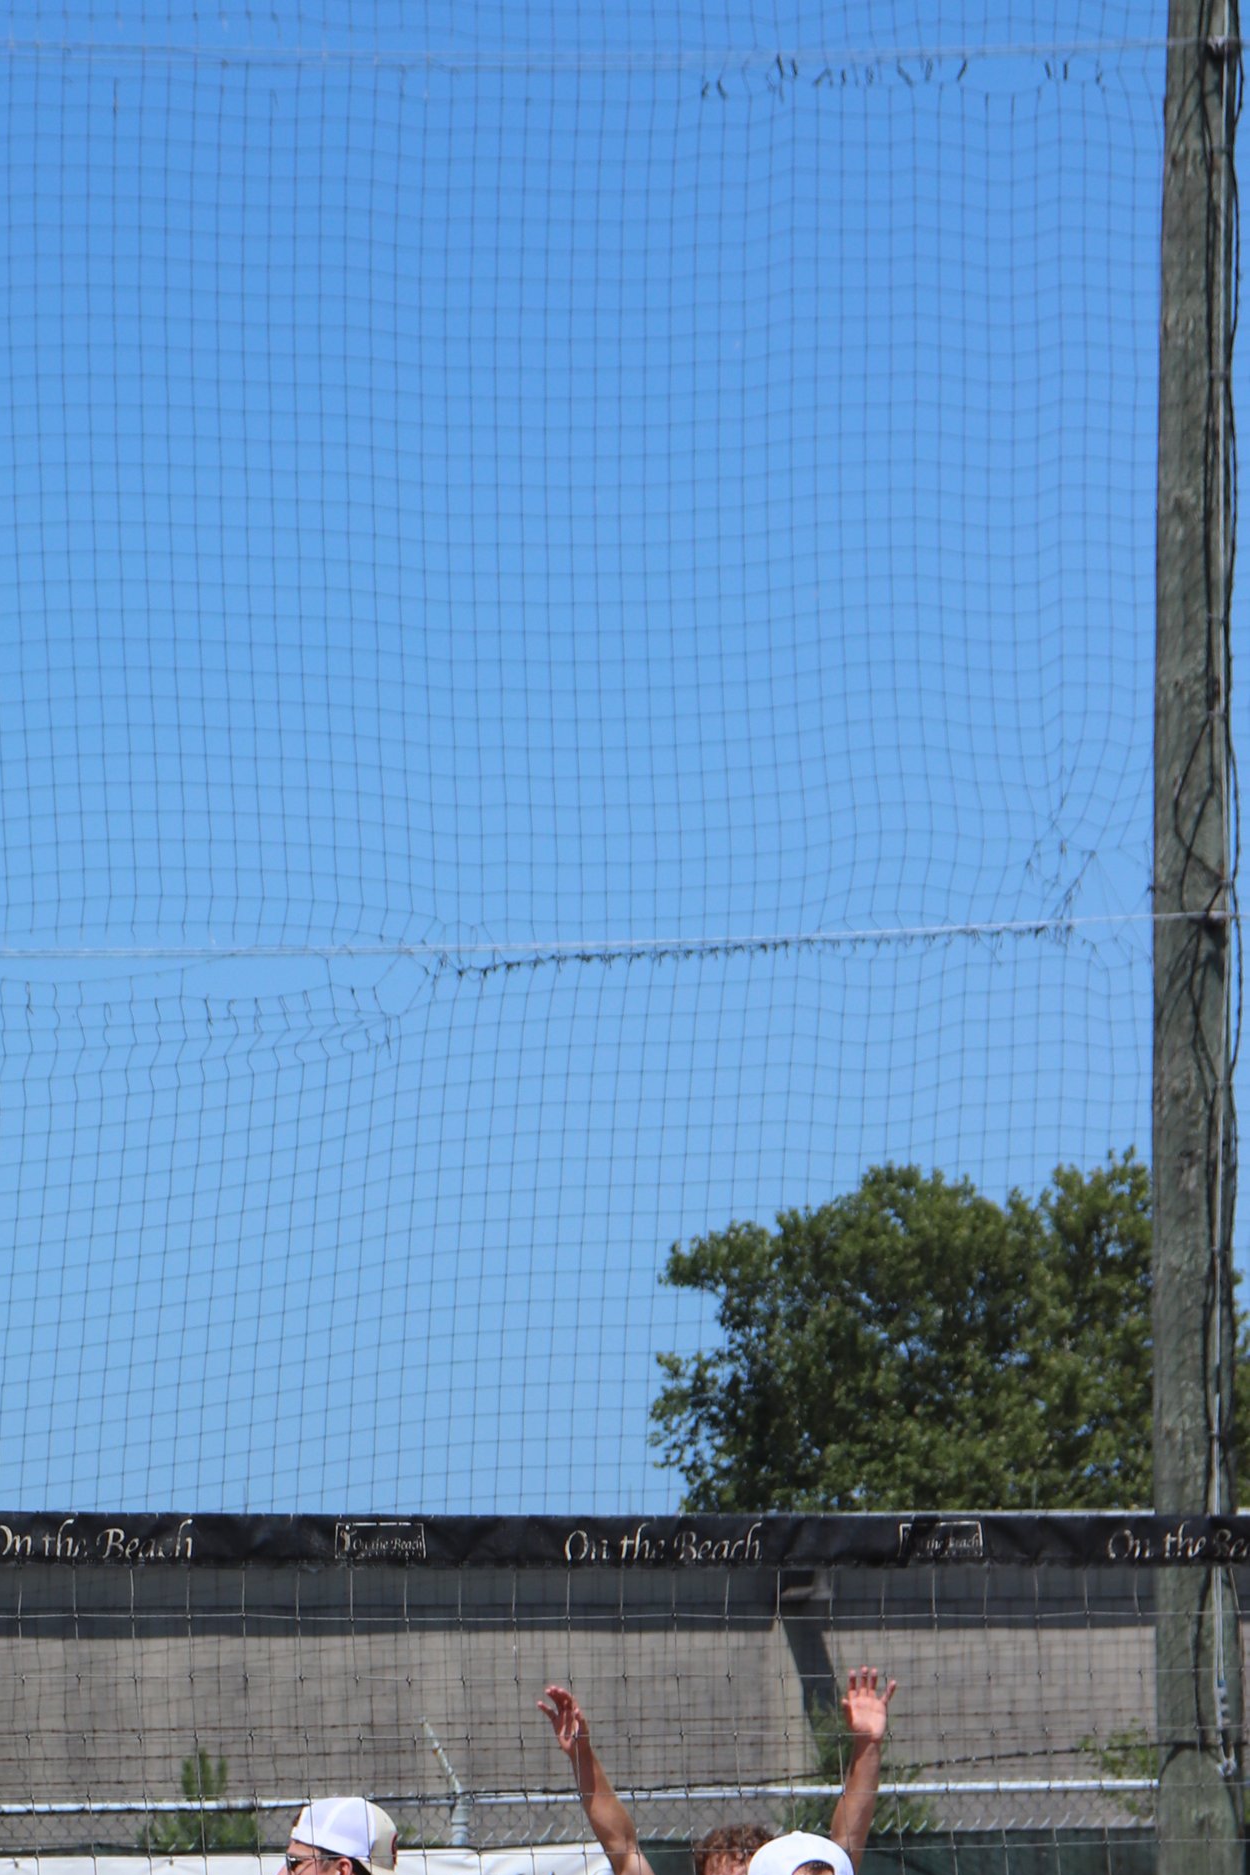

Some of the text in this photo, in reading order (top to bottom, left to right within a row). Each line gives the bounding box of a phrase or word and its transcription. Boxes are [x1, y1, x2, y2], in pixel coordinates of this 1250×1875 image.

[96, 1519, 193, 1559] Beach
[565, 1522, 763, 1561] On the Beach
[1108, 1529, 1153, 1559] On
[1164, 1520, 1206, 1558] the
